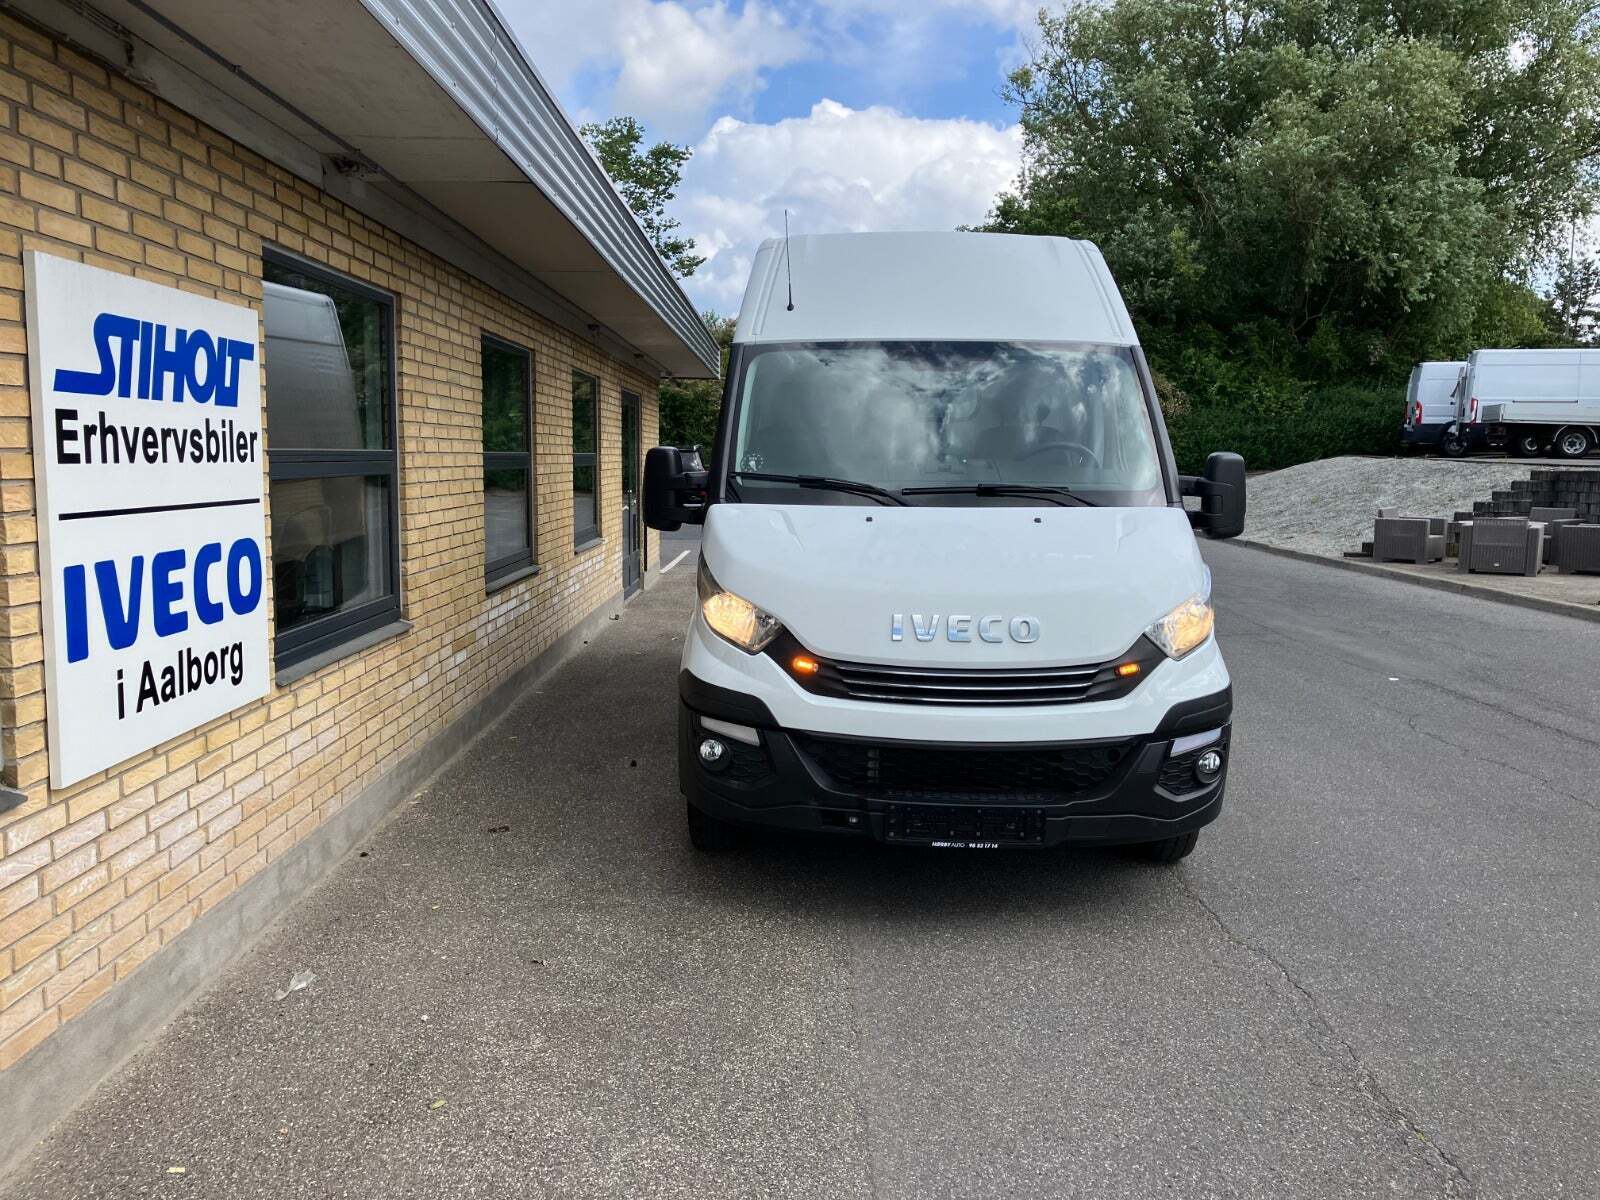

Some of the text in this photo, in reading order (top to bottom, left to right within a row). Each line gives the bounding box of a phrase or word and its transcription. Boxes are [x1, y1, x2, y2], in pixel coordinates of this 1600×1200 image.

[53, 312, 255, 408] STIHOLT
[55, 408, 258, 465] Erhvervsbiler
[63, 537, 262, 664] IVECO
[891, 613, 1041, 644] IVECO
[116, 638, 244, 720] i Aalborg
